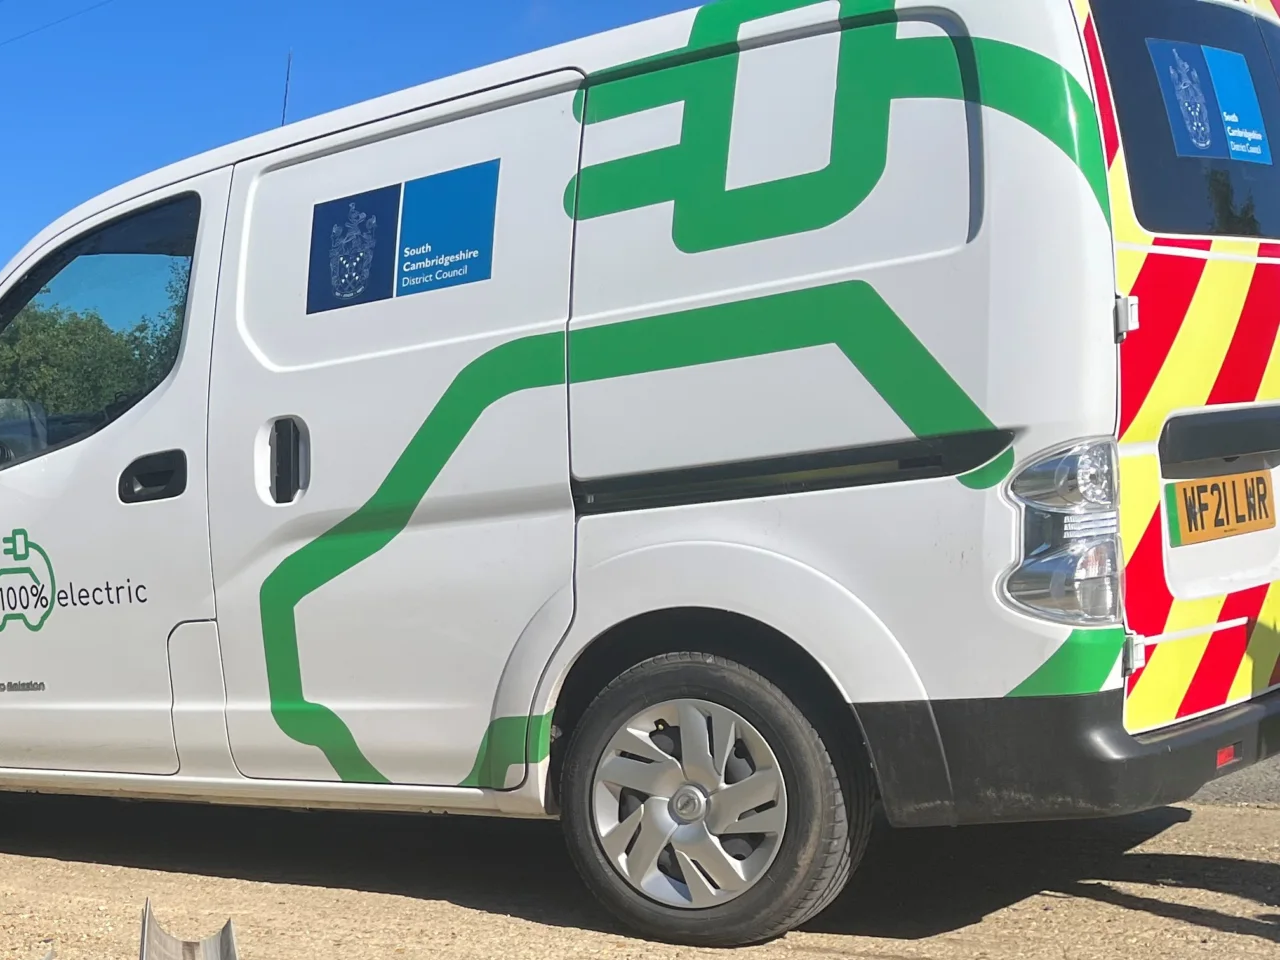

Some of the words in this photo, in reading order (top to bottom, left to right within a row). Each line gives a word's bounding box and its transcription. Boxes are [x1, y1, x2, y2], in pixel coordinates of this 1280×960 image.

[403, 249, 479, 272] Cambridgeshire
[404, 243, 431, 257] South
[402, 273, 433, 287] District
[435, 265, 468, 281] Council
[1183, 482, 1230, 532] WF21
[1232, 476, 1269, 523] LWR
[57, 578, 148, 607] electric
